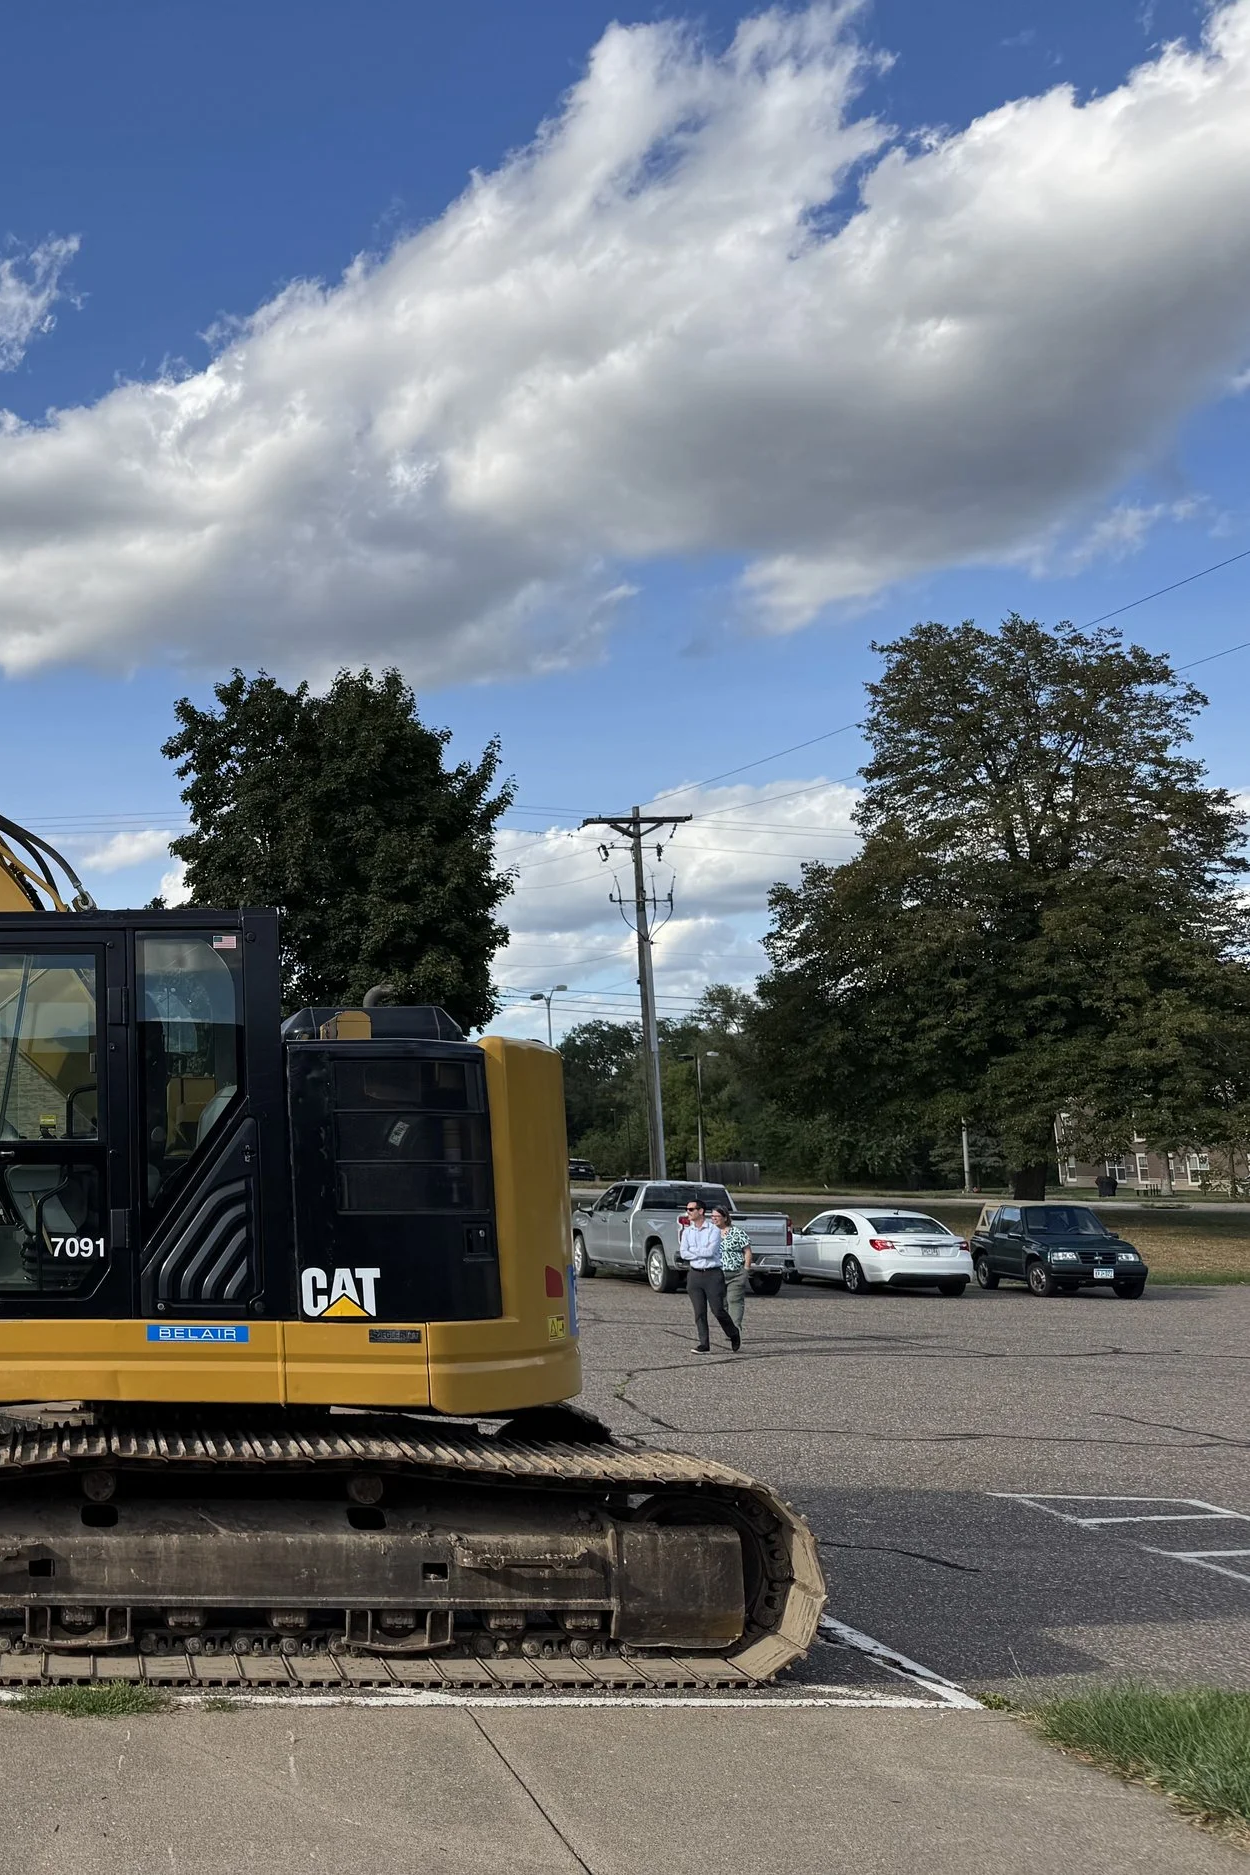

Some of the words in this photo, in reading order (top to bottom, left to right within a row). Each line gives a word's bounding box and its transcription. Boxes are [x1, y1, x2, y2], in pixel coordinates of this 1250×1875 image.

[51, 1237, 104, 1257] 7091
[301, 1267, 380, 1316] CAT
[159, 1328, 236, 1339] BELAIR
